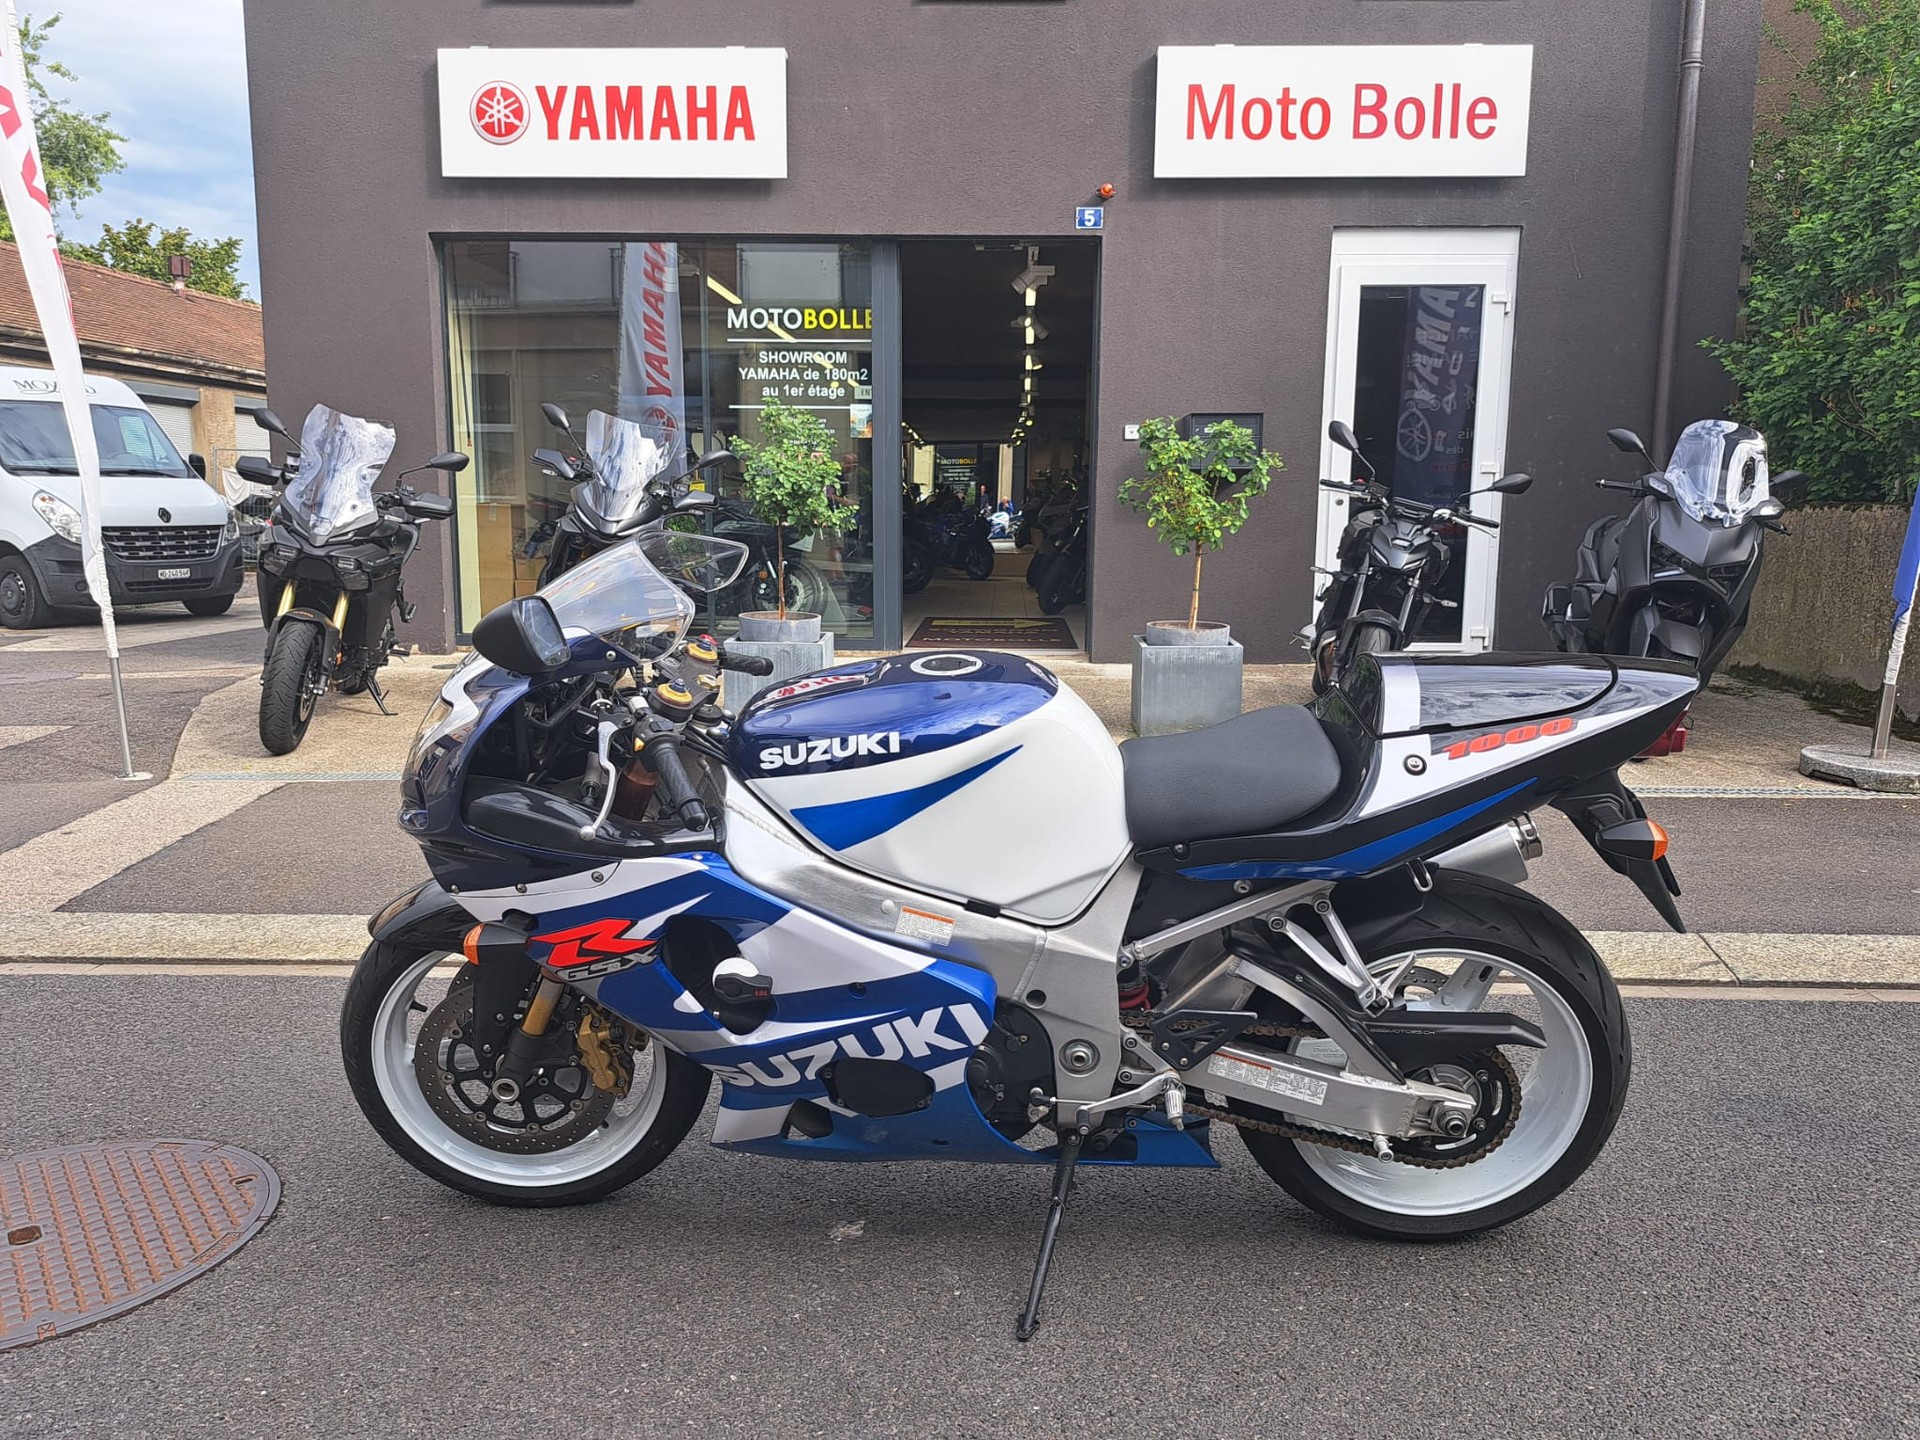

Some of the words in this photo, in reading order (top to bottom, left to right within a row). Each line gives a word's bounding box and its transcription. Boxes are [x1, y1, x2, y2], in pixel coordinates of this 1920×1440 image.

[535, 85, 756, 141] YAMAHA
[1186, 84, 1331, 140] Moto
[1352, 83, 1498, 140] Bolle
[1084, 209, 1096, 227] 5
[738, 367, 800, 380] YAMAHA
[803, 368, 820, 380] de
[824, 368, 869, 380] 180m2
[758, 351, 848, 364] SHOWROOM
[762, 386, 779, 396] au
[783, 384, 804, 396] 1er
[808, 384, 846, 400] étage
[759, 731, 900, 770] SUZUKI
[1442, 717, 1574, 761] 1000
[700, 1003, 989, 1088] SUZUKI
